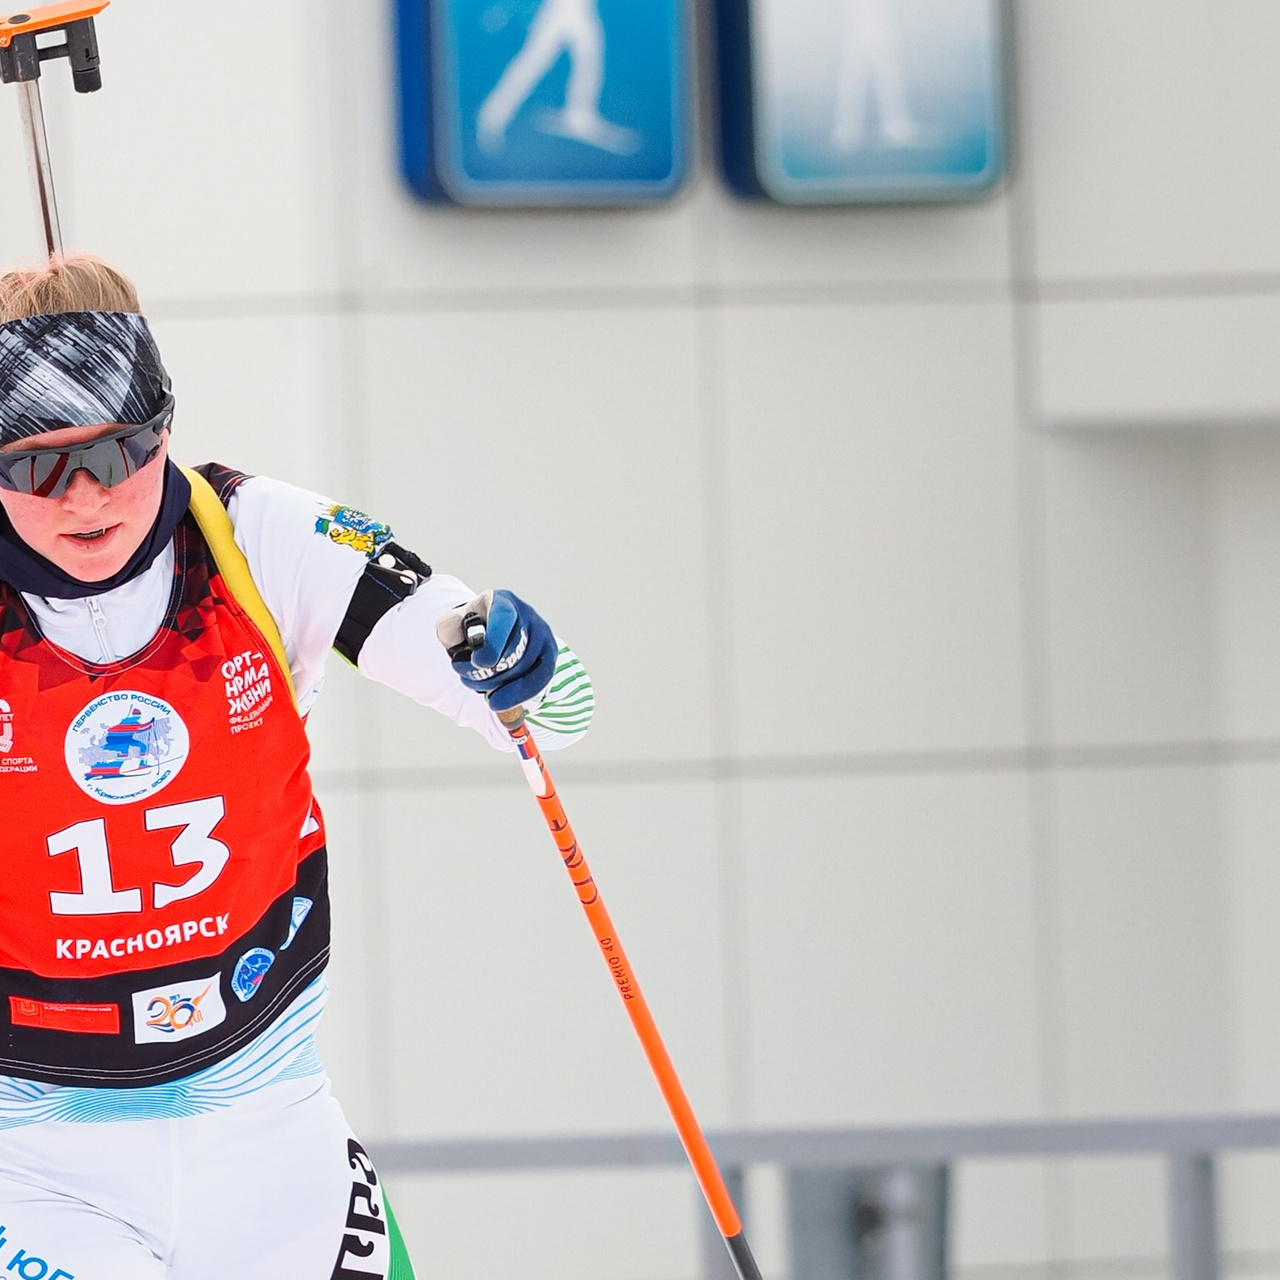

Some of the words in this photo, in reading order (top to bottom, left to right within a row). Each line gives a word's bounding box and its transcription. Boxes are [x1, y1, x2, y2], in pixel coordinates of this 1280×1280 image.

[72, 693, 129, 732] ПЕРВЕНСТВО
[131, 694, 171, 715] РОССИИ
[1, 757, 34, 765] СПОРТА
[46, 794, 231, 916] 13
[55, 912, 230, 960] КРАСНОЯРСК
[600, 937, 613, 952] 40
[608, 956, 635, 1001] PREMIO
